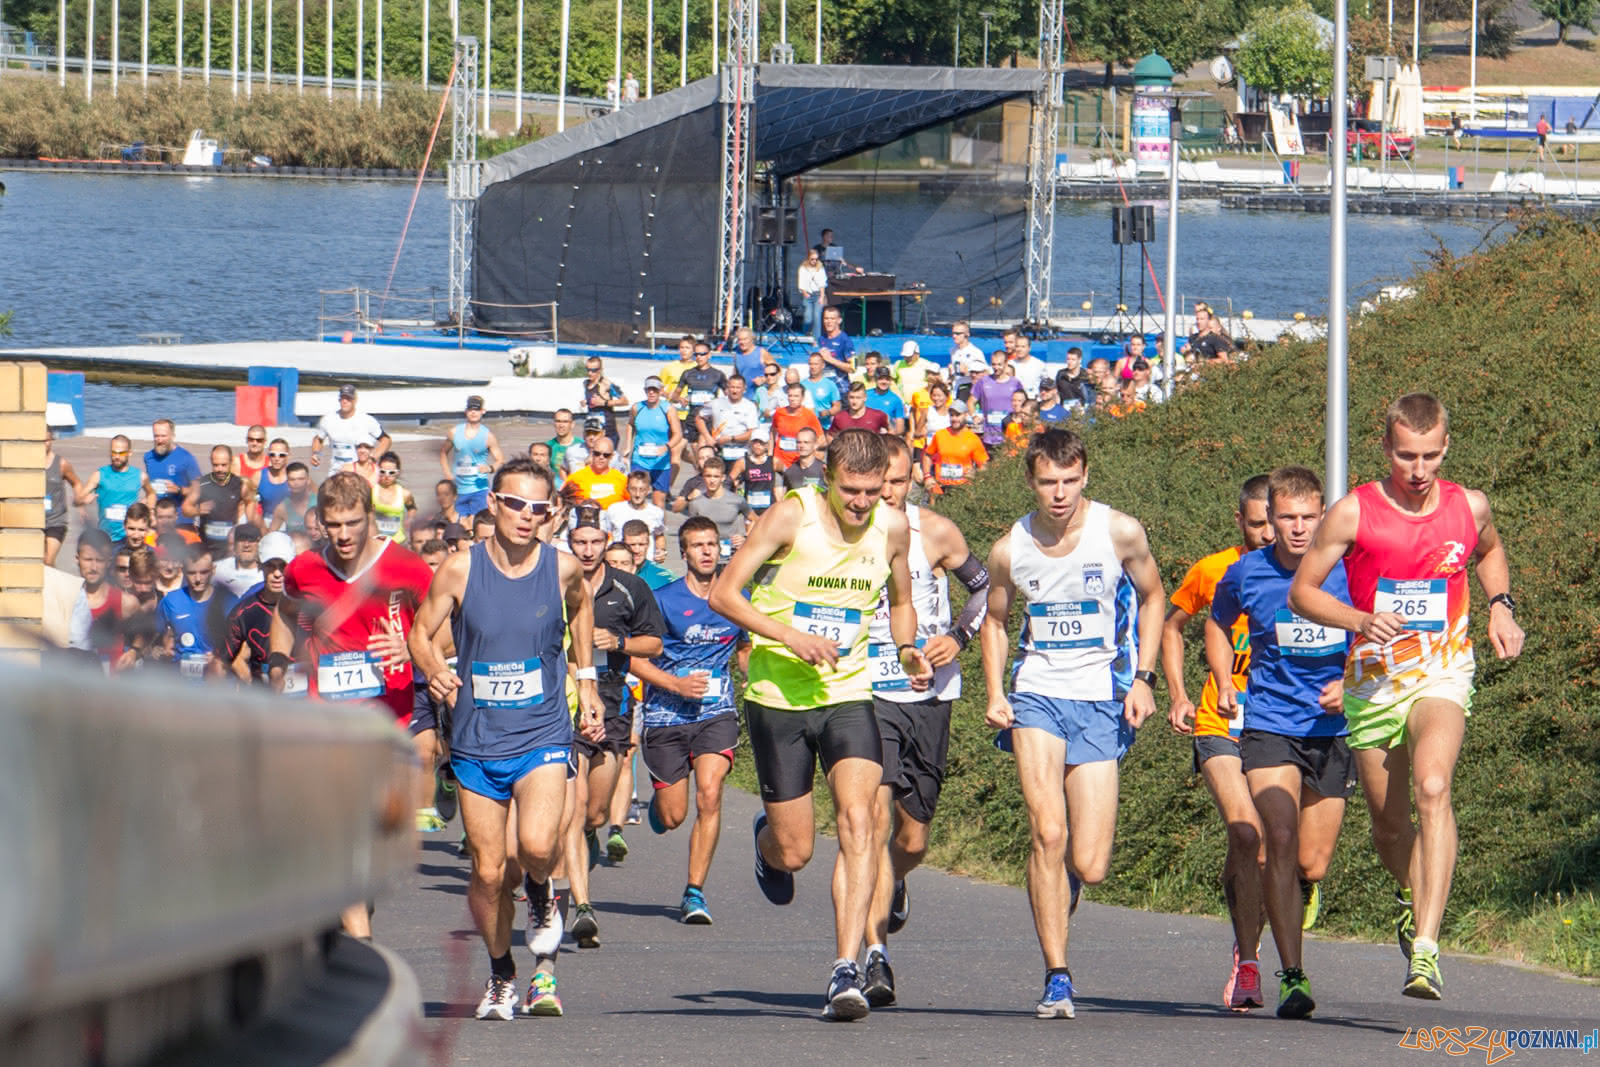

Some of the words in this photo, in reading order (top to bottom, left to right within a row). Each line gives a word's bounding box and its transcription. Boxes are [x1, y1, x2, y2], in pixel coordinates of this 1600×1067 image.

[807, 575, 848, 590] NOWAK
[850, 578, 872, 591] RUN
[1392, 599, 1428, 616] 265
[807, 624, 841, 641] 513
[1047, 620, 1082, 636] 709
[1292, 627, 1327, 643] 234
[879, 660, 901, 676] 38
[333, 668, 364, 687] 171
[489, 679, 525, 696] 772
